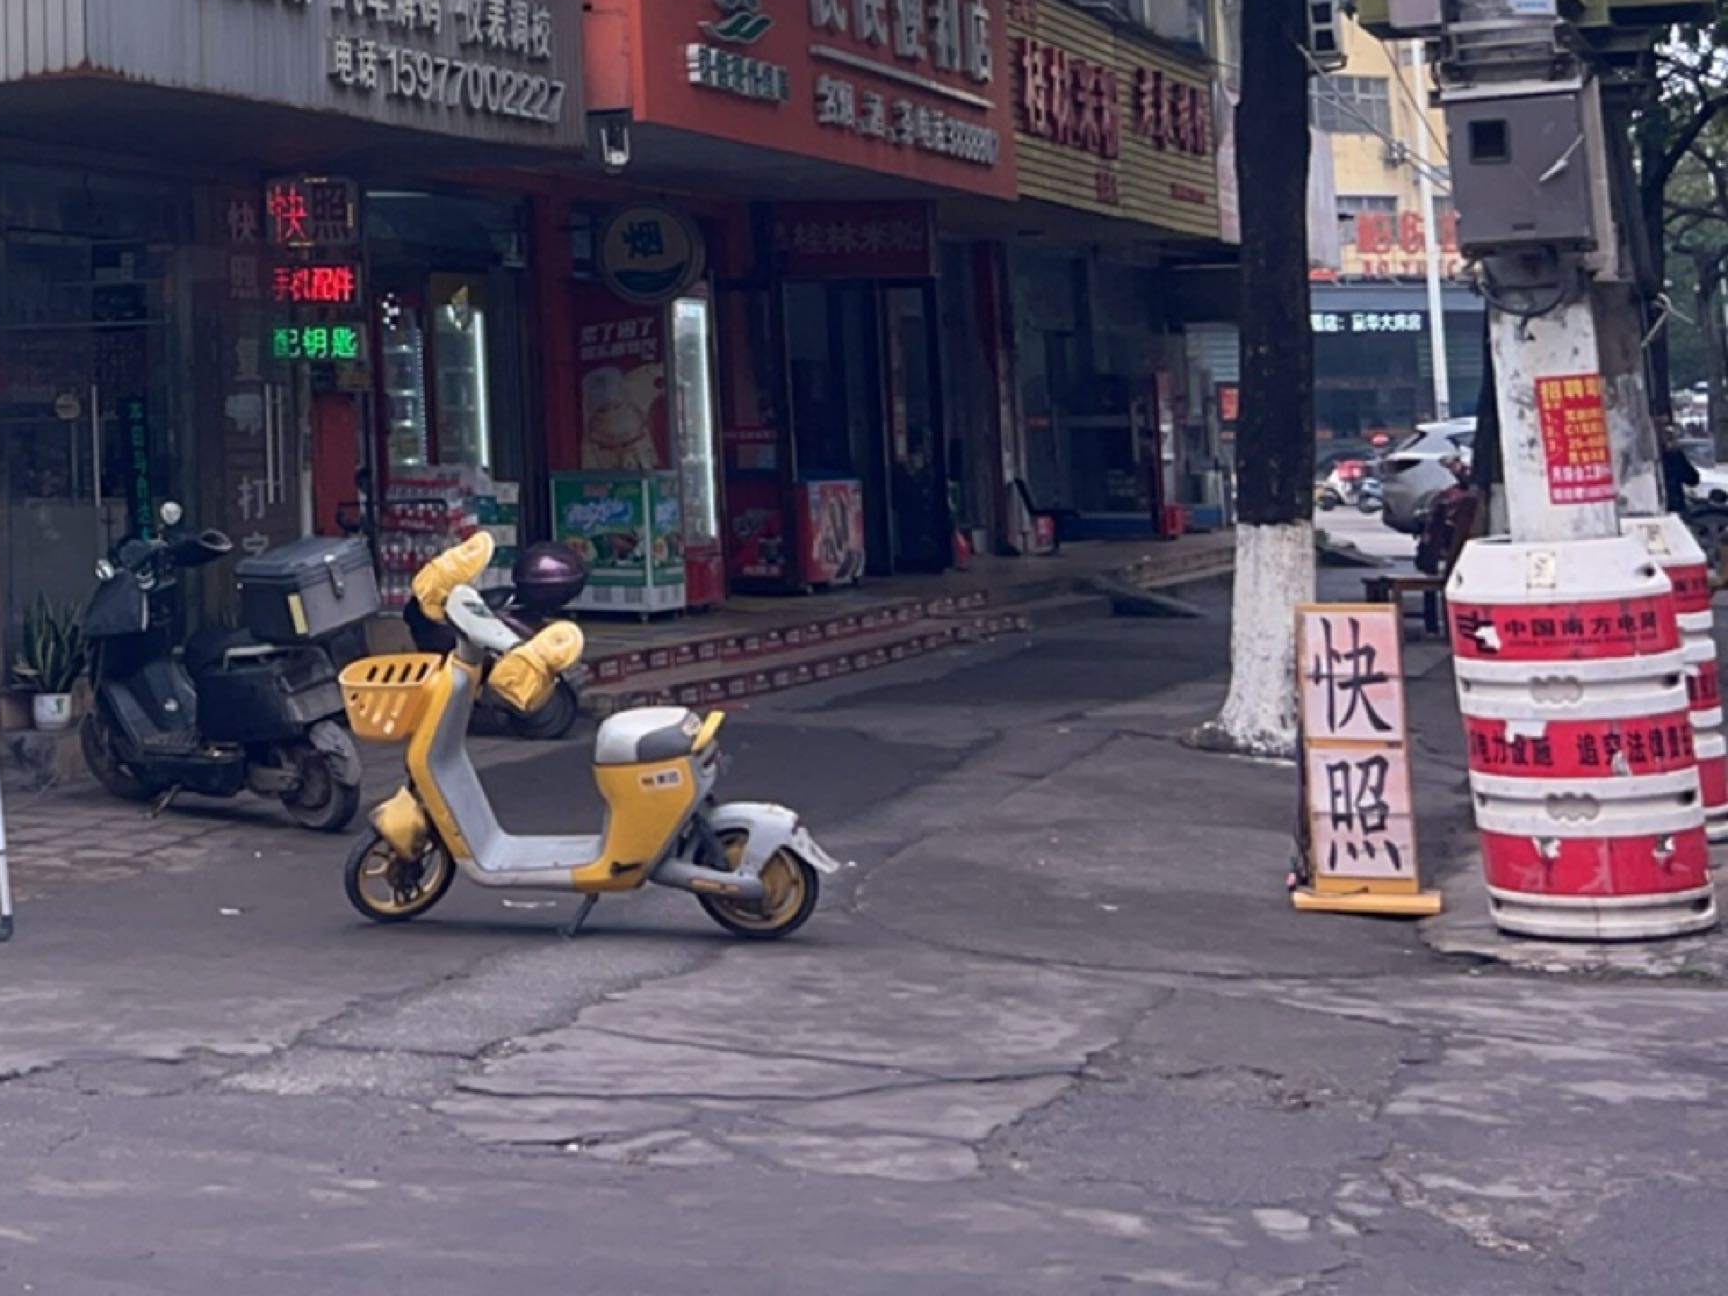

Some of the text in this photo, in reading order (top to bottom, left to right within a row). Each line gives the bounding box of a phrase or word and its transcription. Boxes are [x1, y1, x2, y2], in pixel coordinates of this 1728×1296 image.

[330, 34, 567, 124] 电话 15977002227
[1312, 616, 1403, 871] 快照
